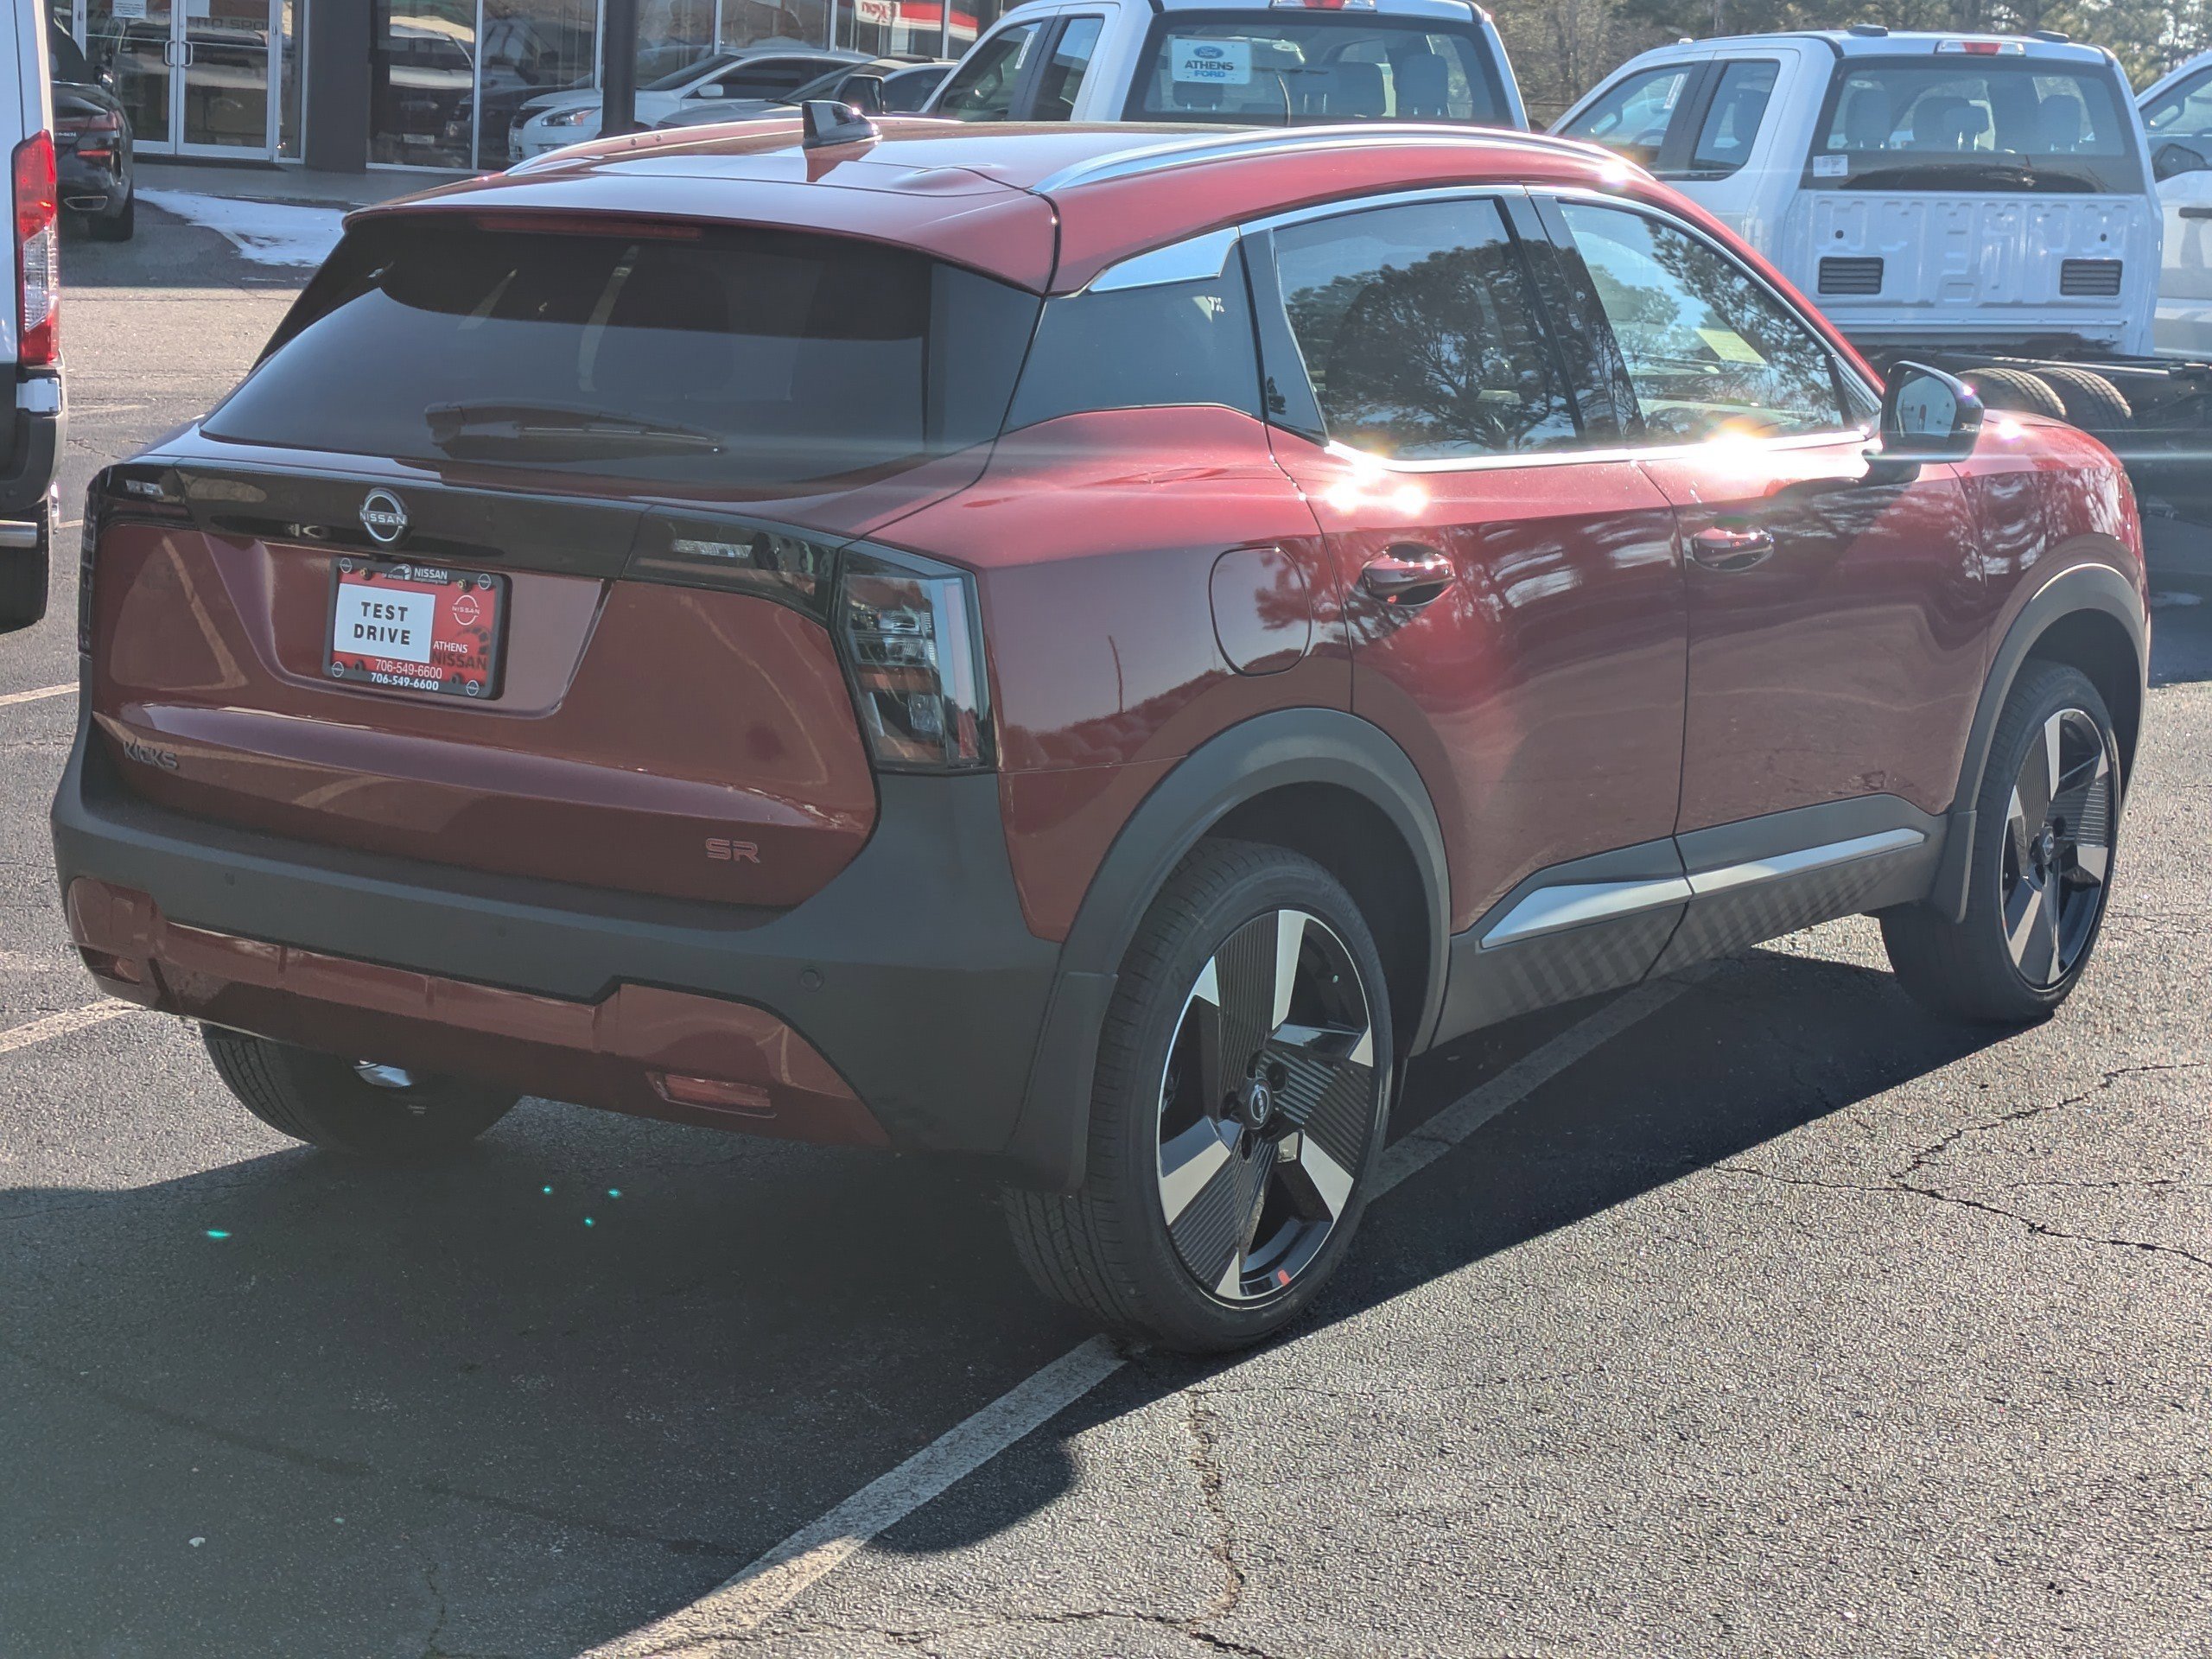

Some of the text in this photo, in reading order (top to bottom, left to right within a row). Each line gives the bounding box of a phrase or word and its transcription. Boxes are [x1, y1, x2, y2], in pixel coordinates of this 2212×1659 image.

[1185, 60, 1234, 70] ATHENS
[359, 512, 406, 524] NISSAN
[414, 568, 448, 580] NISSAN
[360, 601, 409, 622] TEST
[452, 606, 480, 614] NISSAN
[353, 623, 410, 645] DRIVE
[433, 640, 468, 654] ATHENS
[375, 658, 442, 679] 706-549-6600
[431, 652, 487, 671] NISSAN
[371, 672, 439, 691] 706-549-6600
[705, 837, 760, 863] SR
